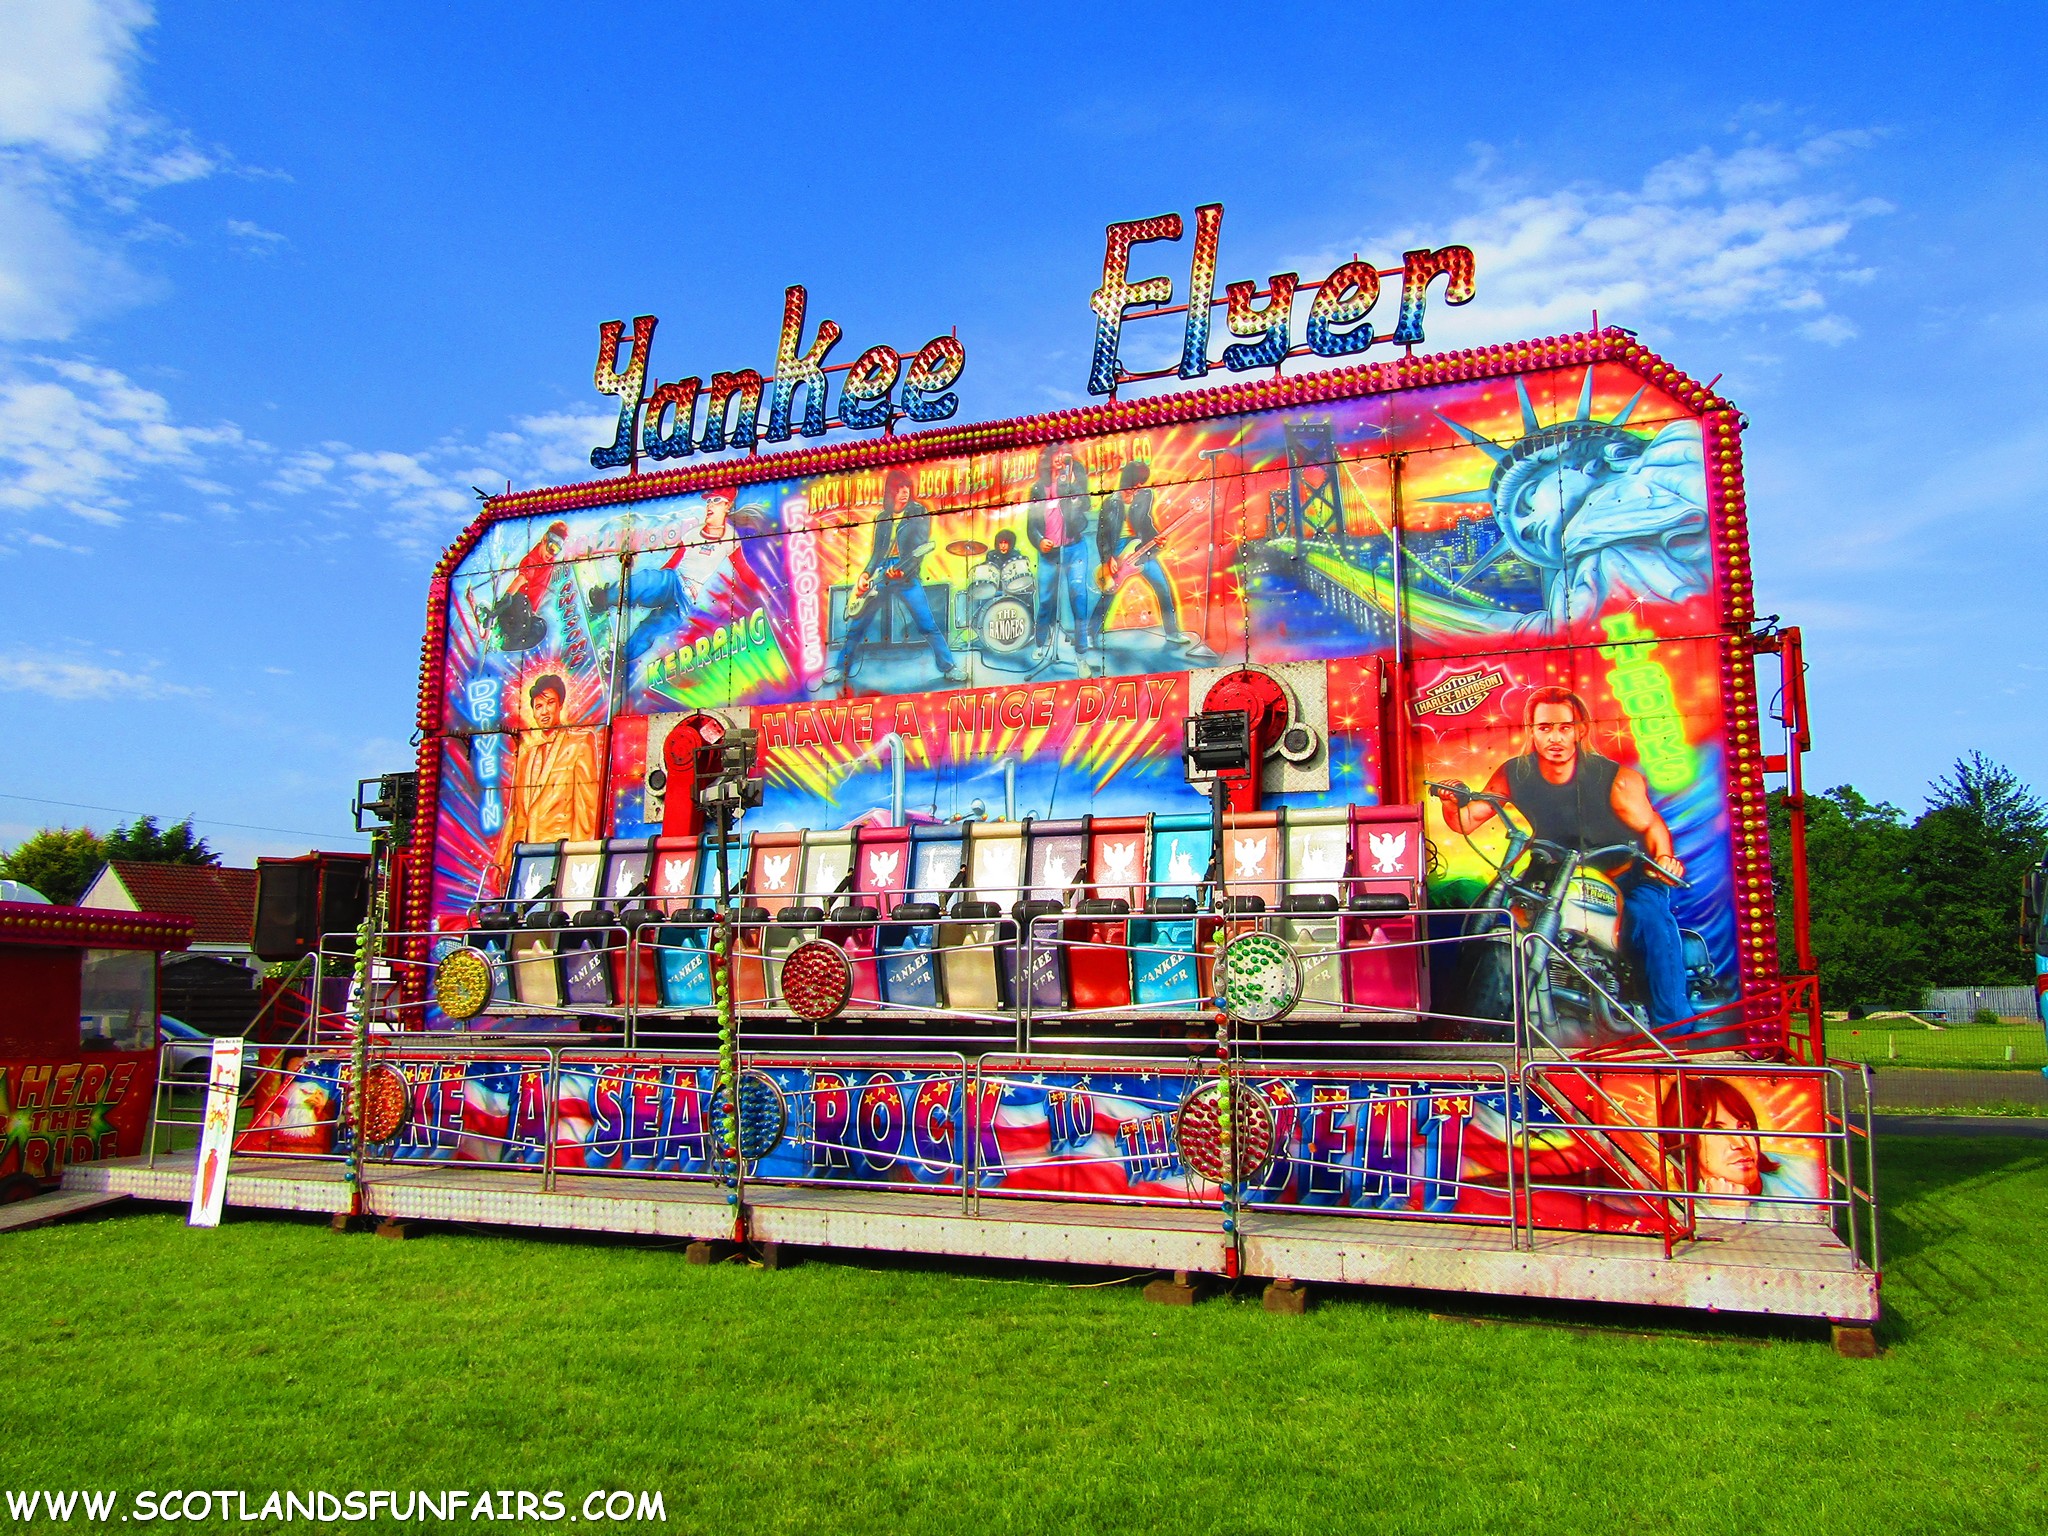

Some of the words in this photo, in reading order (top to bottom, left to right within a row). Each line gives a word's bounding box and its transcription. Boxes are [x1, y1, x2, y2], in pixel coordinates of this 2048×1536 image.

[589, 284, 965, 470] Yankee
[1087, 202, 1478, 397] Flyer
[809, 481, 839, 515] ROCK
[918, 468, 949, 498] ROCK
[1132, 437, 1151, 465] GO
[998, 609, 1017, 620] THE
[647, 607, 766, 687] KERRANG
[1419, 675, 1499, 712] HARLEY-DAVIDSON
[1434, 674, 1479, 695] MOTOR
[1441, 694, 1483, 713] CYCLES
[761, 703, 873, 750] HAVE
[895, 702, 923, 740] A
[948, 687, 1056, 734] NICE
[1076, 678, 1178, 725] DAY
[18, 1062, 137, 1109] HERE
[30, 1107, 93, 1133] THE
[512, 1064, 548, 1152] A
[811, 1073, 1007, 1177] ROCK
[1047, 1085, 1094, 1141] TO
